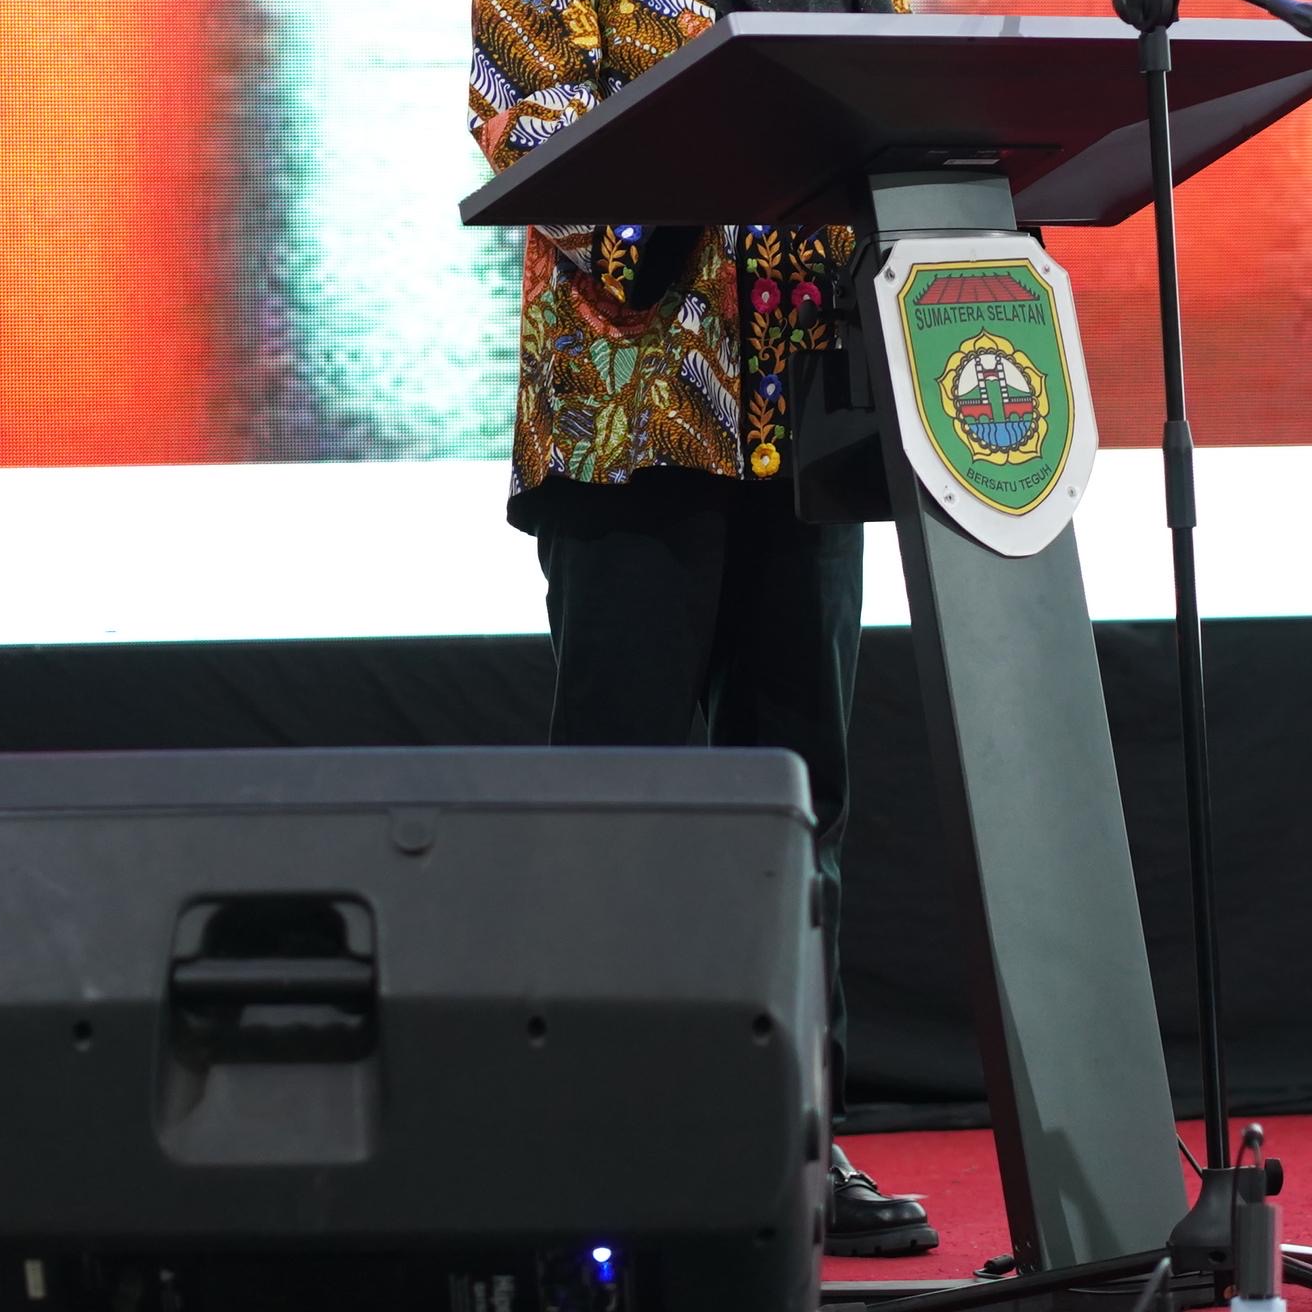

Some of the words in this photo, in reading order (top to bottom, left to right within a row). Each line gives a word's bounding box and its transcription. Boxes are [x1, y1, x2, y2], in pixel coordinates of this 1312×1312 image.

[914, 305, 986, 331] SUMATERA
[987, 303, 1046, 326] SELATAN
[966, 467, 1018, 492] BERSATU
[1018, 463, 1052, 490] TEGUH
